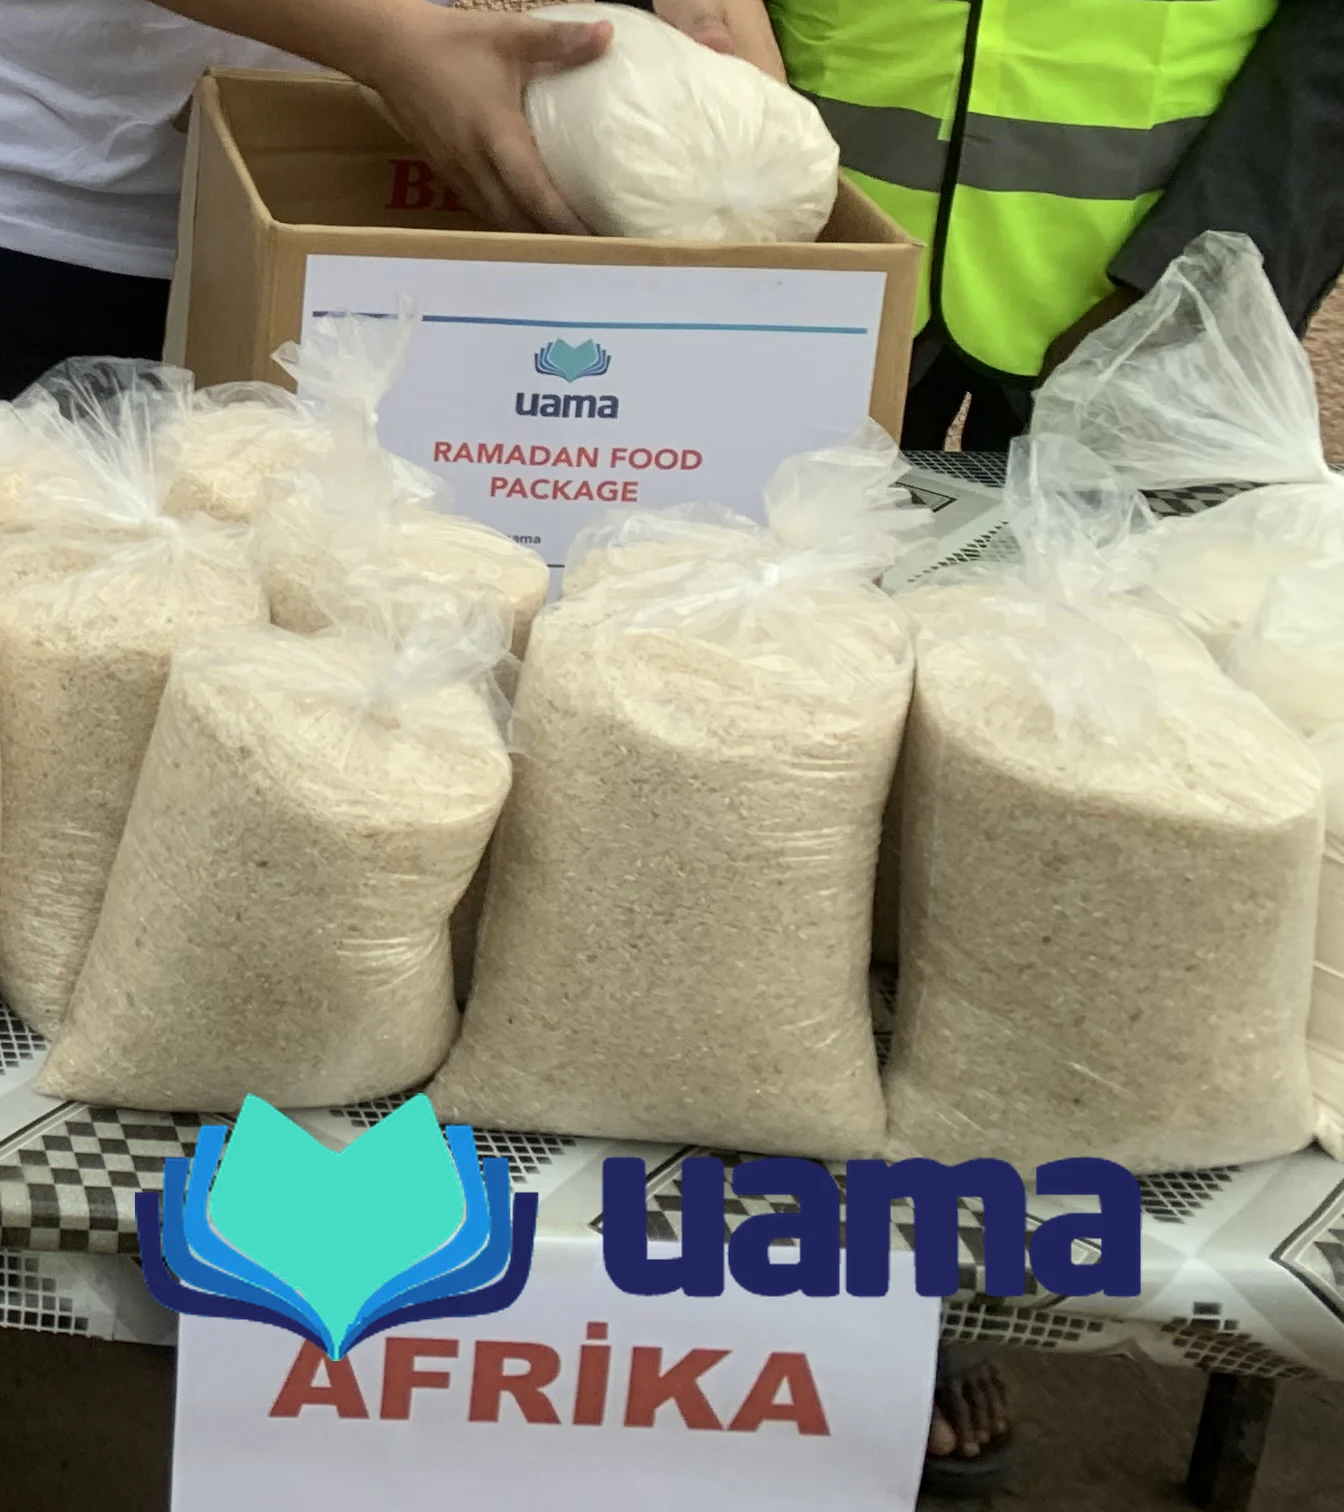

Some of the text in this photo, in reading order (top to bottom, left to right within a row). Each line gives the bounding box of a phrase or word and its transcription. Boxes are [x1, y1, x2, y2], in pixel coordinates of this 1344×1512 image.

[515, 392, 619, 419] uama
[433, 441, 703, 470] RAMADAN FOOD
[490, 476, 639, 503] PACKAGE
[508, 535, 541, 544] ama
[267, 1321, 831, 1437] AFRİKA
